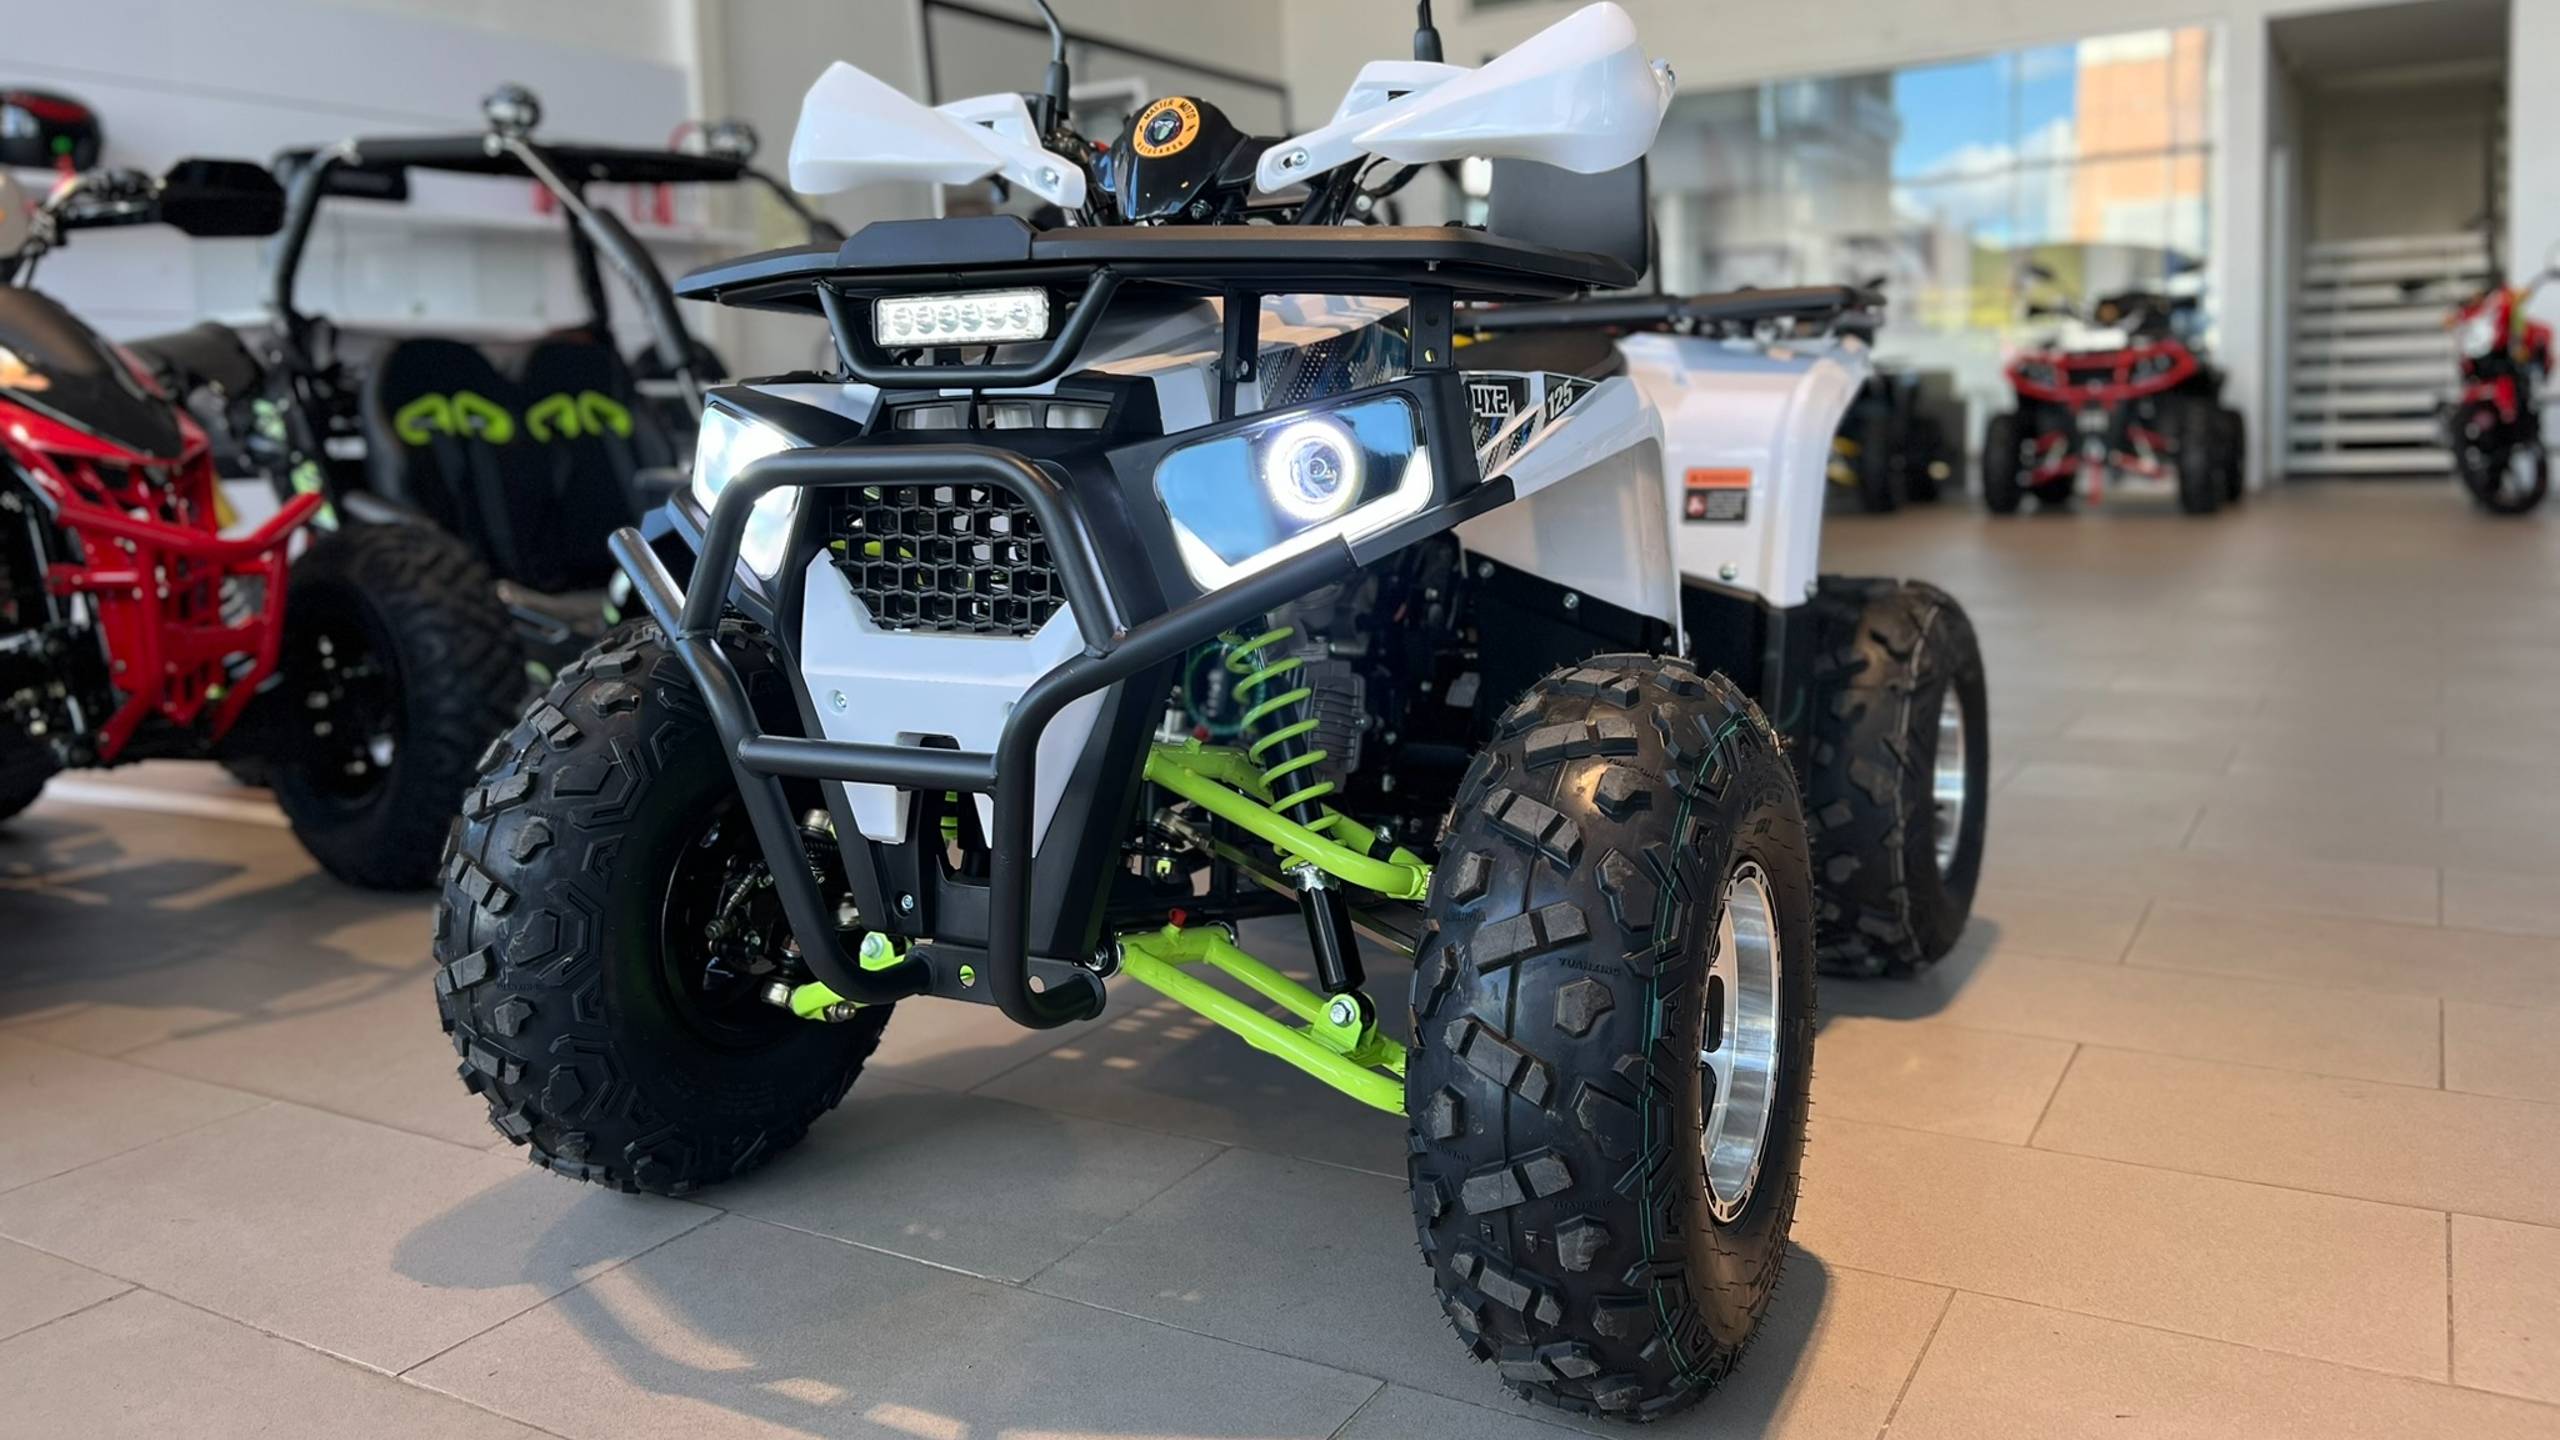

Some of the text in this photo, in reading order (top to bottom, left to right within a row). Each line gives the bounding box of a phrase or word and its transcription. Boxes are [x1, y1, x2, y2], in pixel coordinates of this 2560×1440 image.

[1144, 100, 1197, 120] MASTER MOTO
[1471, 386, 1508, 416] 4X2
[1547, 379, 1573, 419] 125
